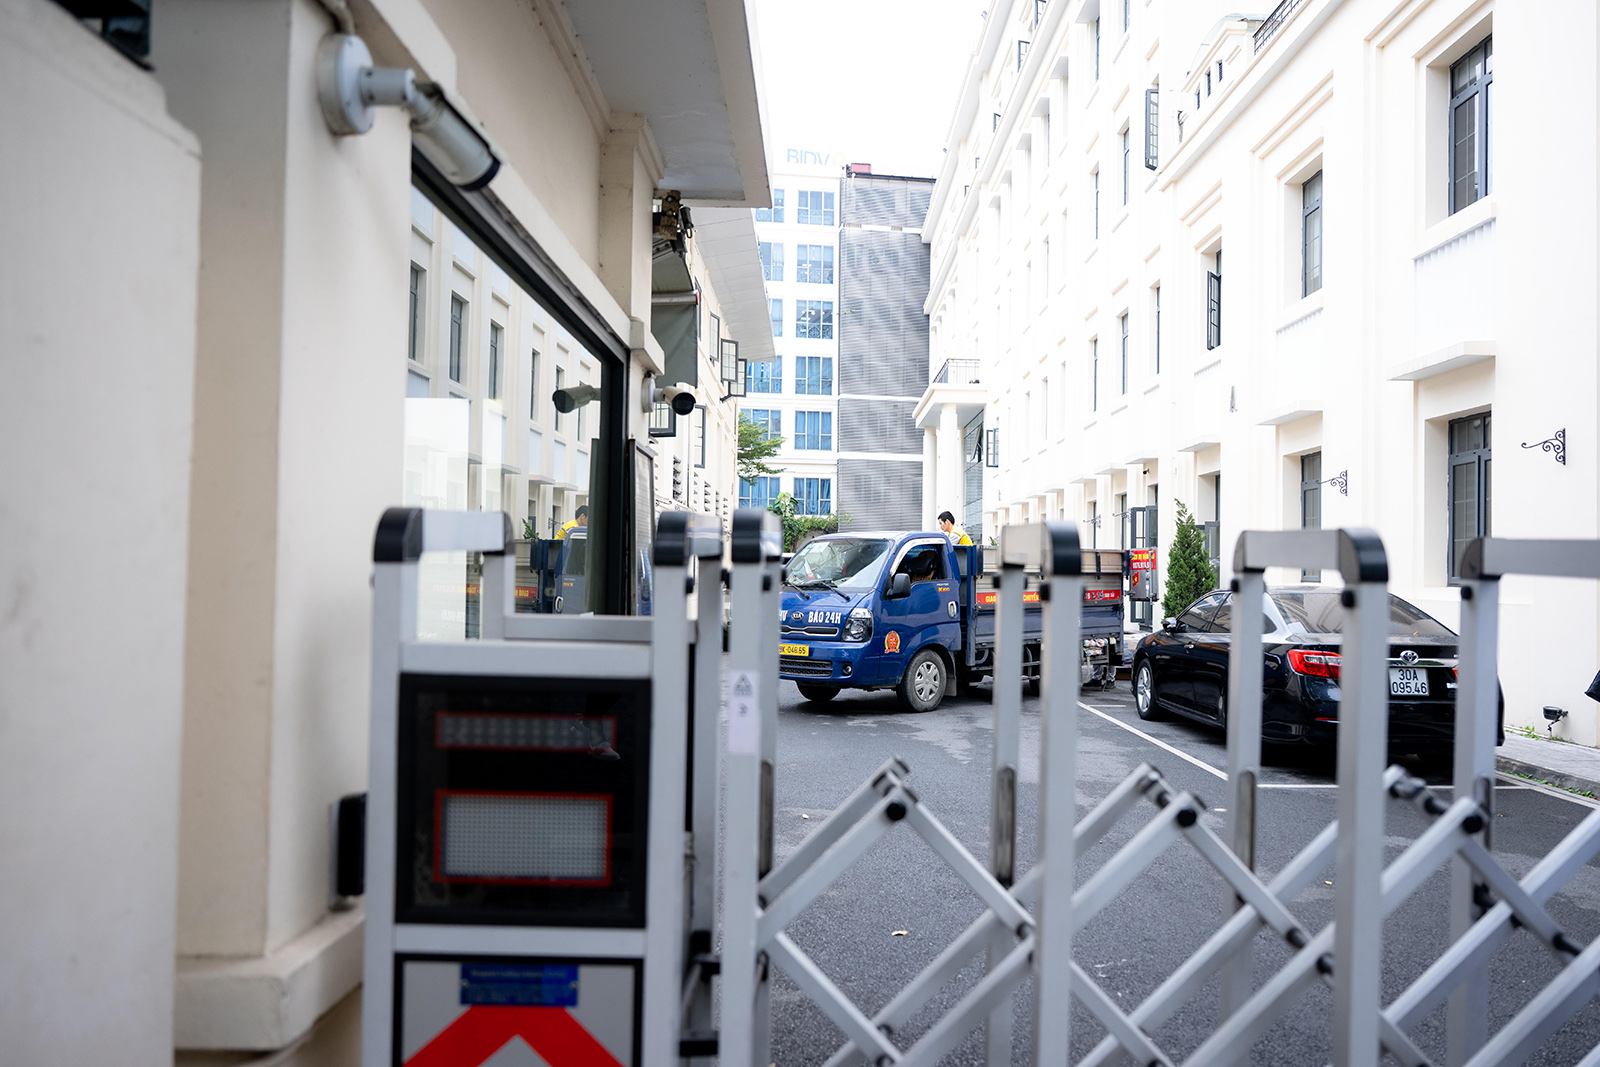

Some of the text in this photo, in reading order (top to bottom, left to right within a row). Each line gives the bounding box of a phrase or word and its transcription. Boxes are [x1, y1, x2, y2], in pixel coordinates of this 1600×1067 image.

[985, 595, 996, 603] GIAO
[808, 609, 842, 624] BÁO 24H
[1398, 668, 1418, 681] 30A
[1392, 681, 1427, 694] 095.46
